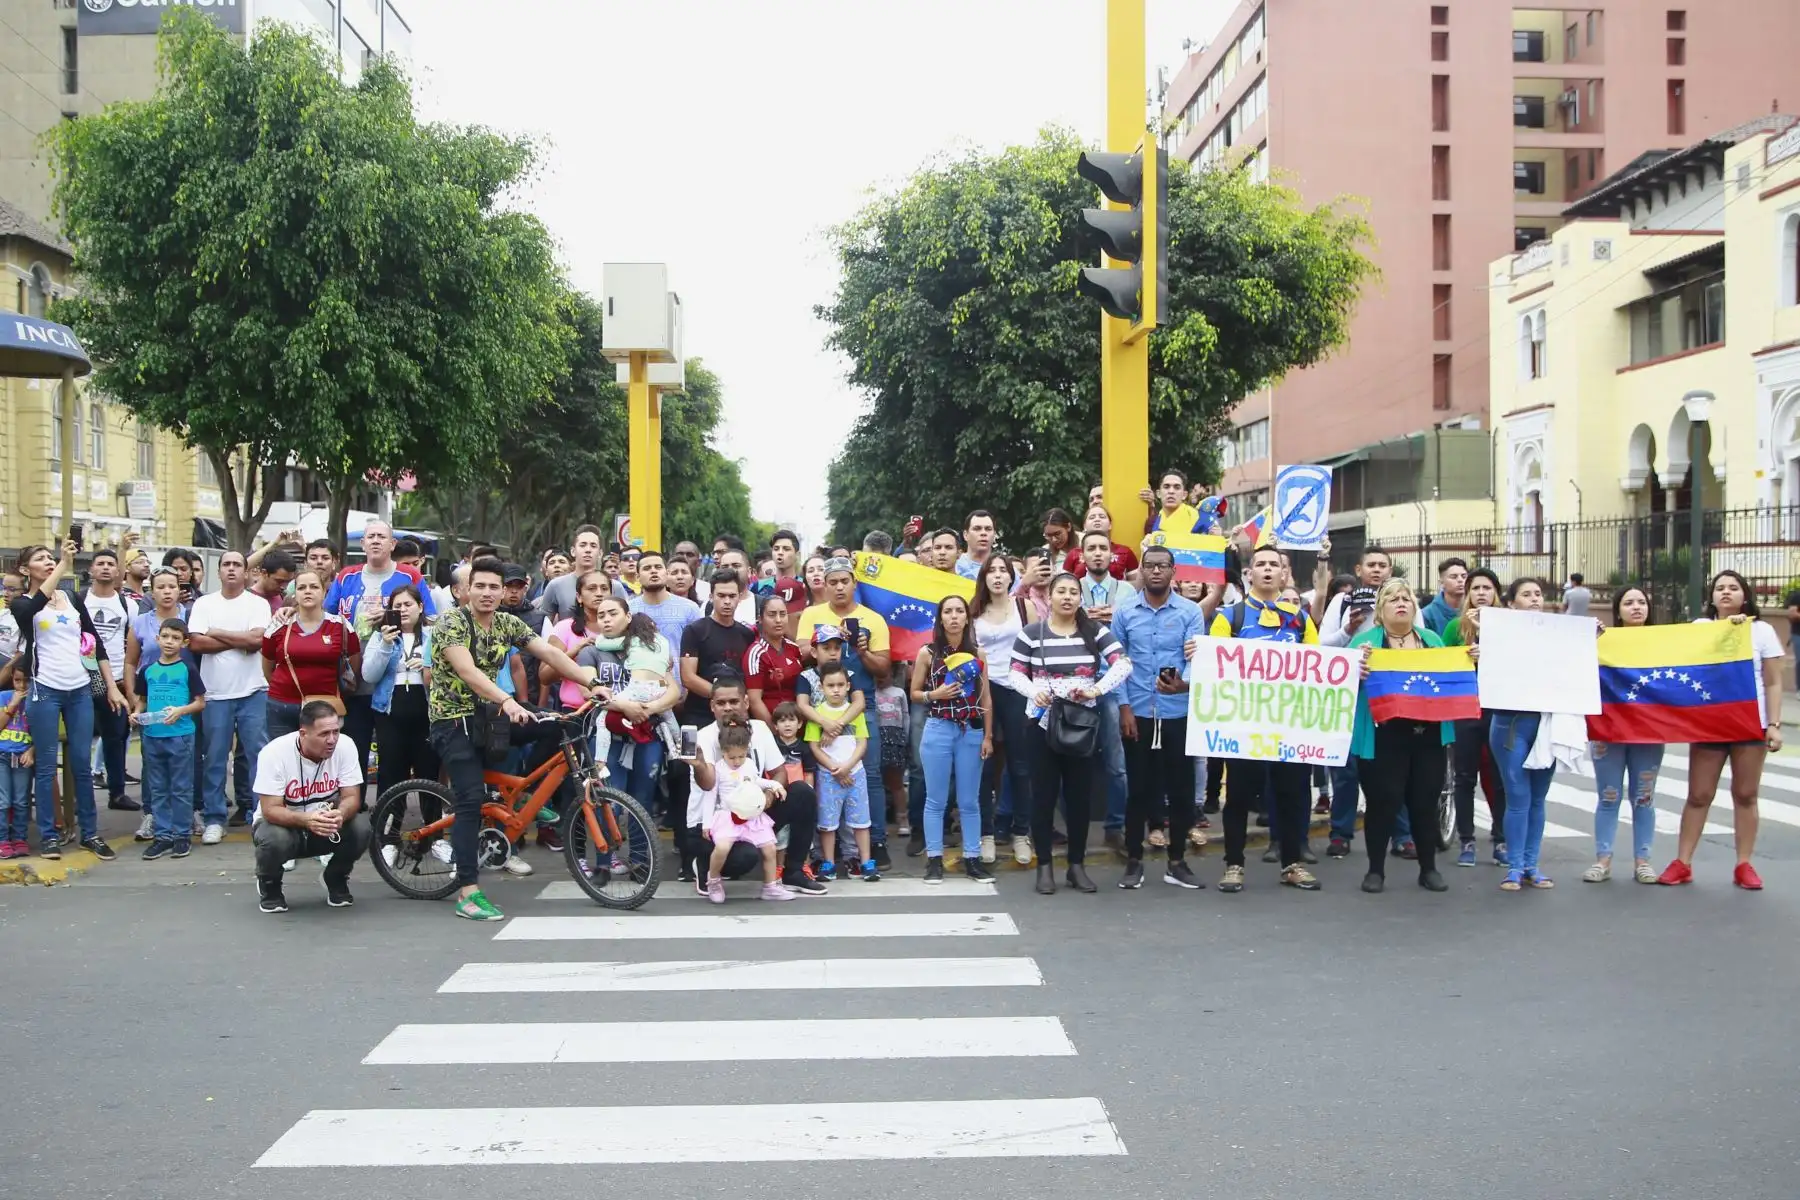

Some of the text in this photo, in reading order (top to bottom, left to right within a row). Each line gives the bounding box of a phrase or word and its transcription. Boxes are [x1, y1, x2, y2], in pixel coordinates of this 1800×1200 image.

[15, 321, 79, 351] INCA
[1215, 644, 1350, 686] MADURO
[1193, 679, 1355, 735] USURPADOR
[1205, 729, 1240, 754] Viva
